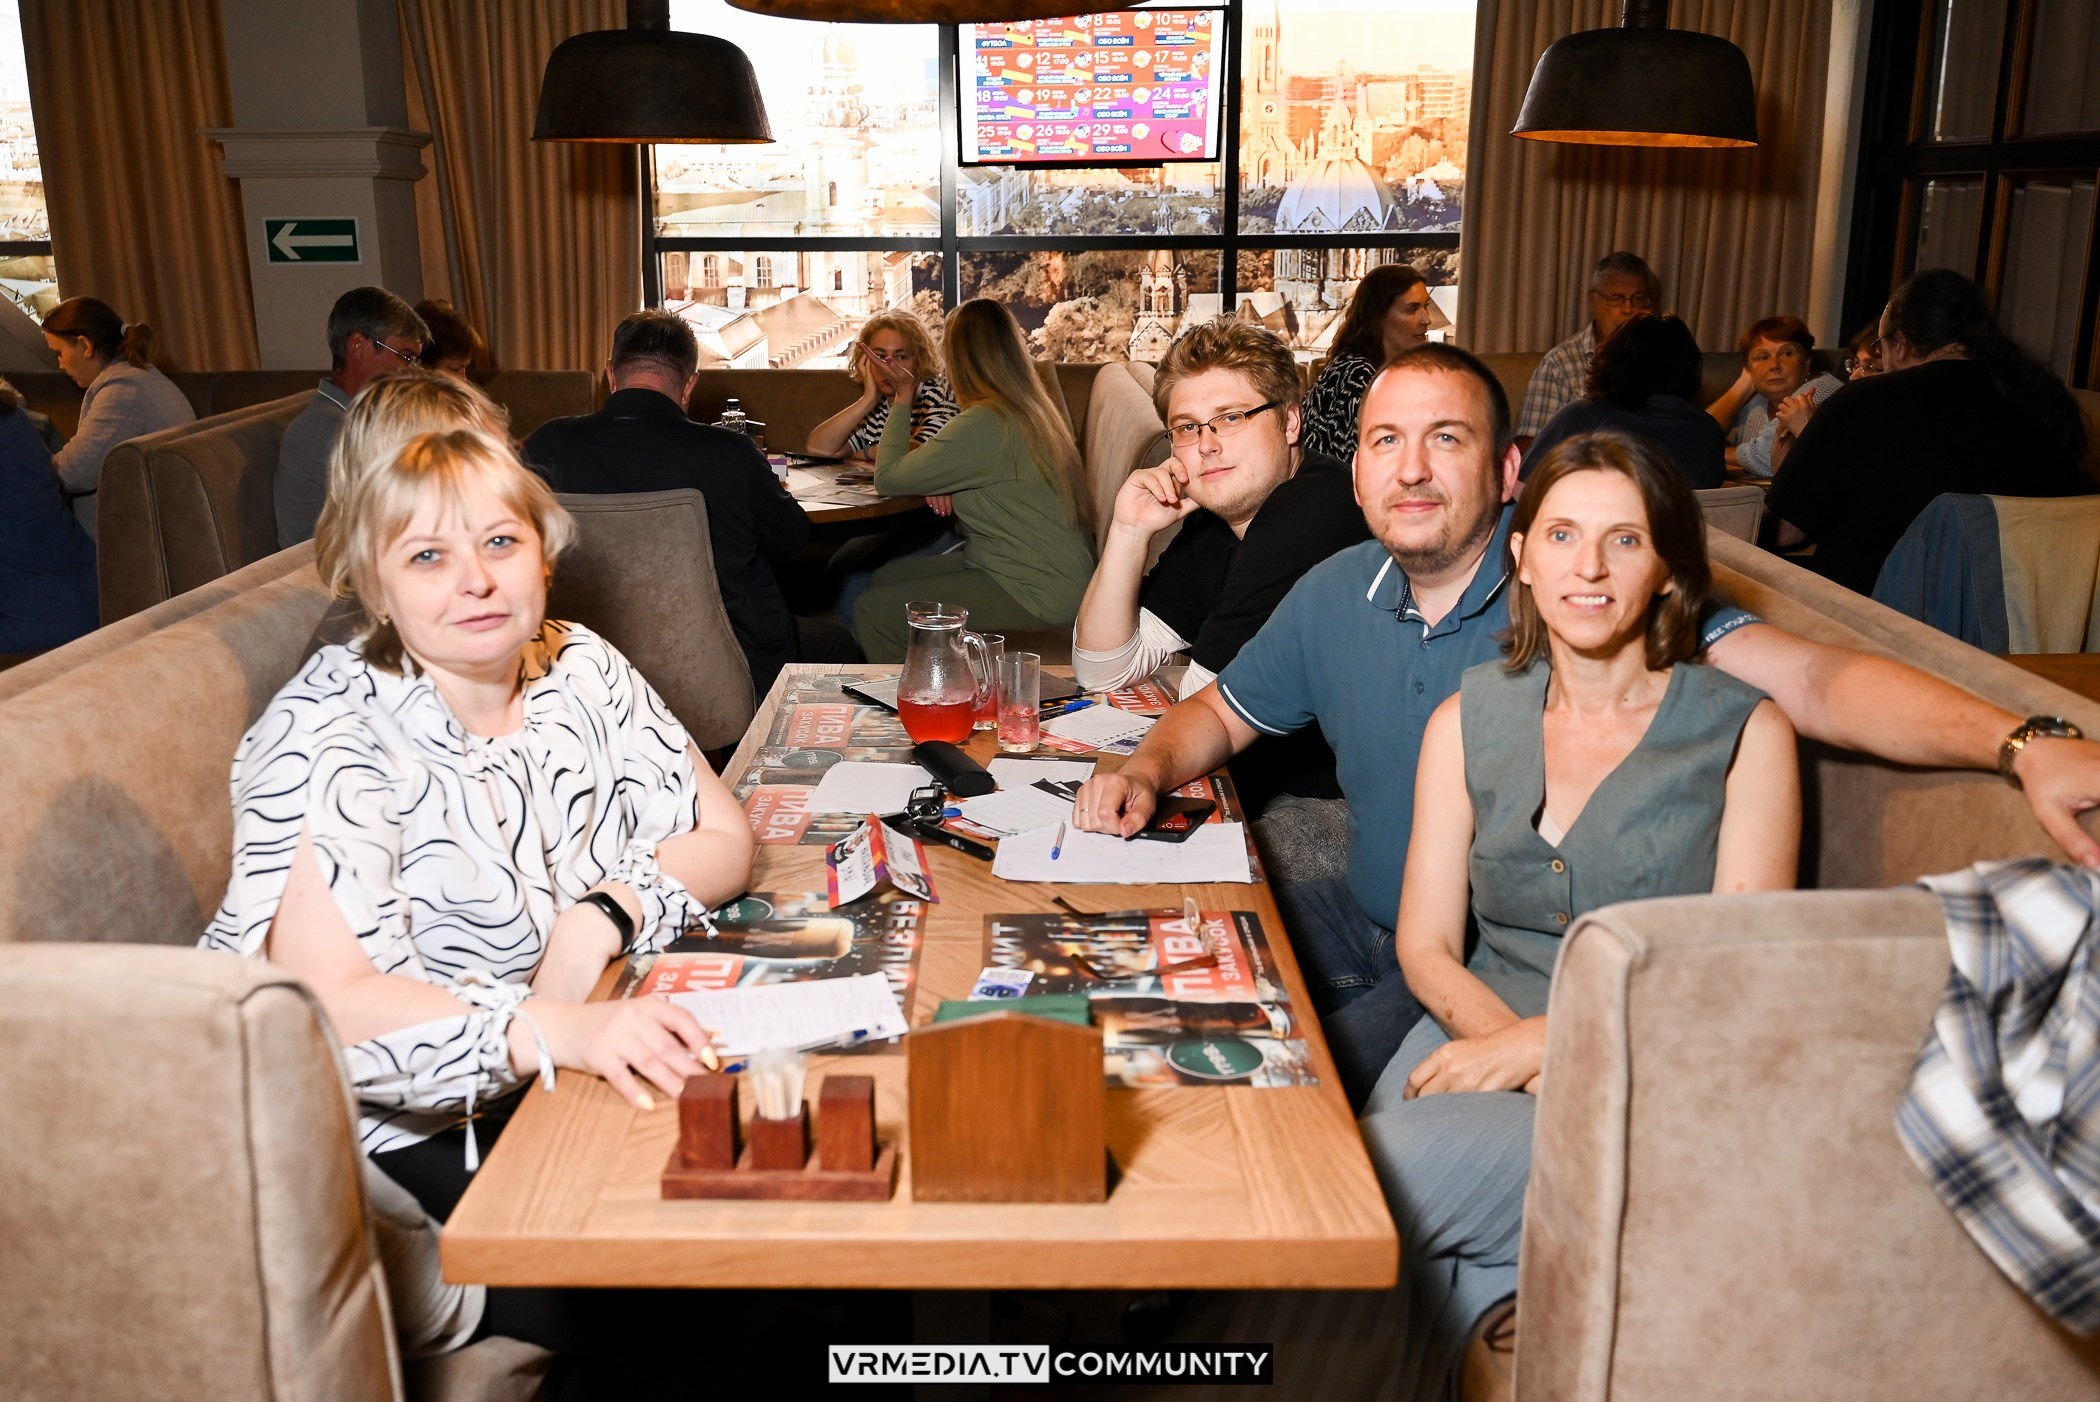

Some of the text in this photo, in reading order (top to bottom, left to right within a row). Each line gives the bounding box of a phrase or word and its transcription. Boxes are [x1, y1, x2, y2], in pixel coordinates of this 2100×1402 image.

[1094, 14, 1103, 26] 8
[1155, 12, 1170, 26] 10
[1035, 52, 1050, 65] 12
[1093, 51, 1109, 64] 15
[1154, 50, 1170, 63] 17
[977, 90, 991, 102] 18
[1036, 89, 1050, 101] 19
[1093, 87, 1111, 100] 22
[1152, 87, 1171, 100] 24
[978, 126, 995, 138] 25
[1036, 125, 1054, 137] 26
[1092, 124, 1111, 136] 29
[793, 711, 814, 744] ЗАКУСОК
[814, 705, 848, 745] ПИВА
[748, 797, 771, 831] ЗАКУС
[760, 789, 814, 840] ПИВА
[685, 960, 734, 992] ПИ
[878, 900, 920, 1043] БЕЗЛИ
